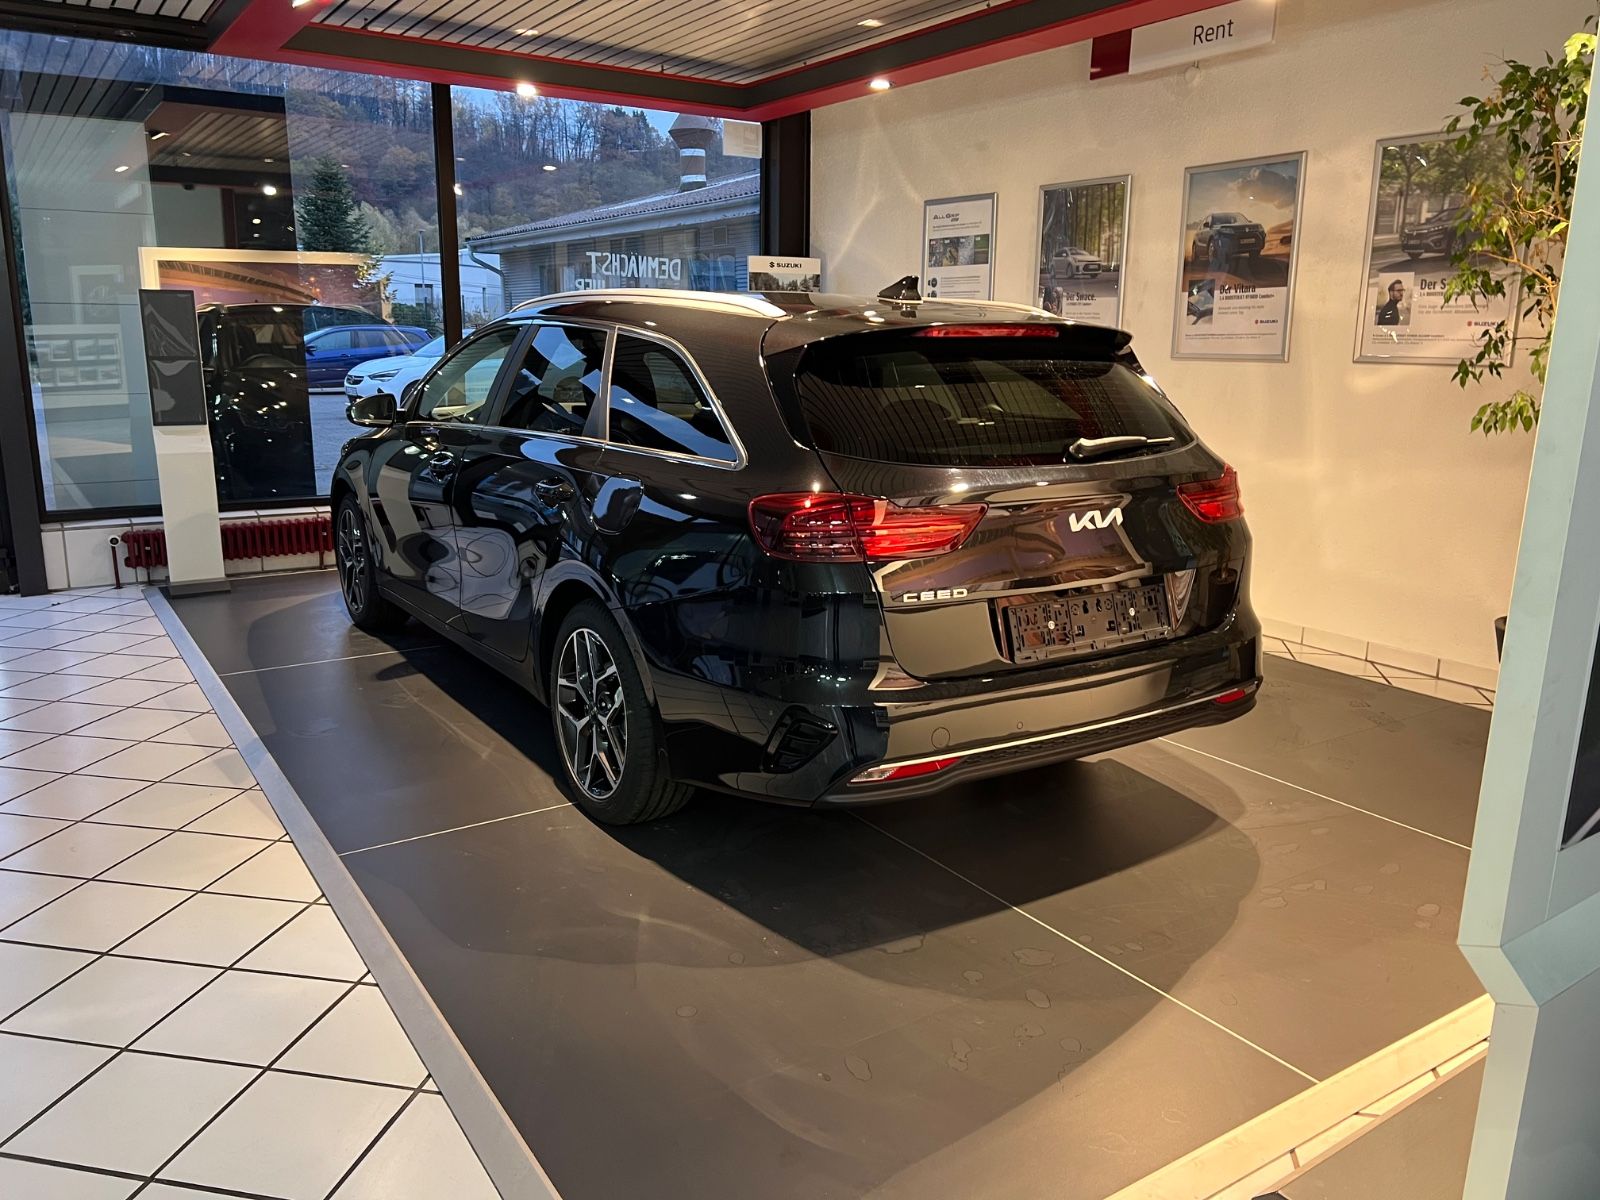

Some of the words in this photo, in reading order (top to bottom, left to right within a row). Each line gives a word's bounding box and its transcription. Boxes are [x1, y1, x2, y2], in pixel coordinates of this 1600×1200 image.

[1193, 18, 1234, 46] Rent
[1220, 284, 1232, 294] Der
[1234, 284, 1256, 293] Vitara
[1420, 279, 1437, 290] Der
[1068, 507, 1124, 533] KIA
[903, 588, 968, 603] CEED
